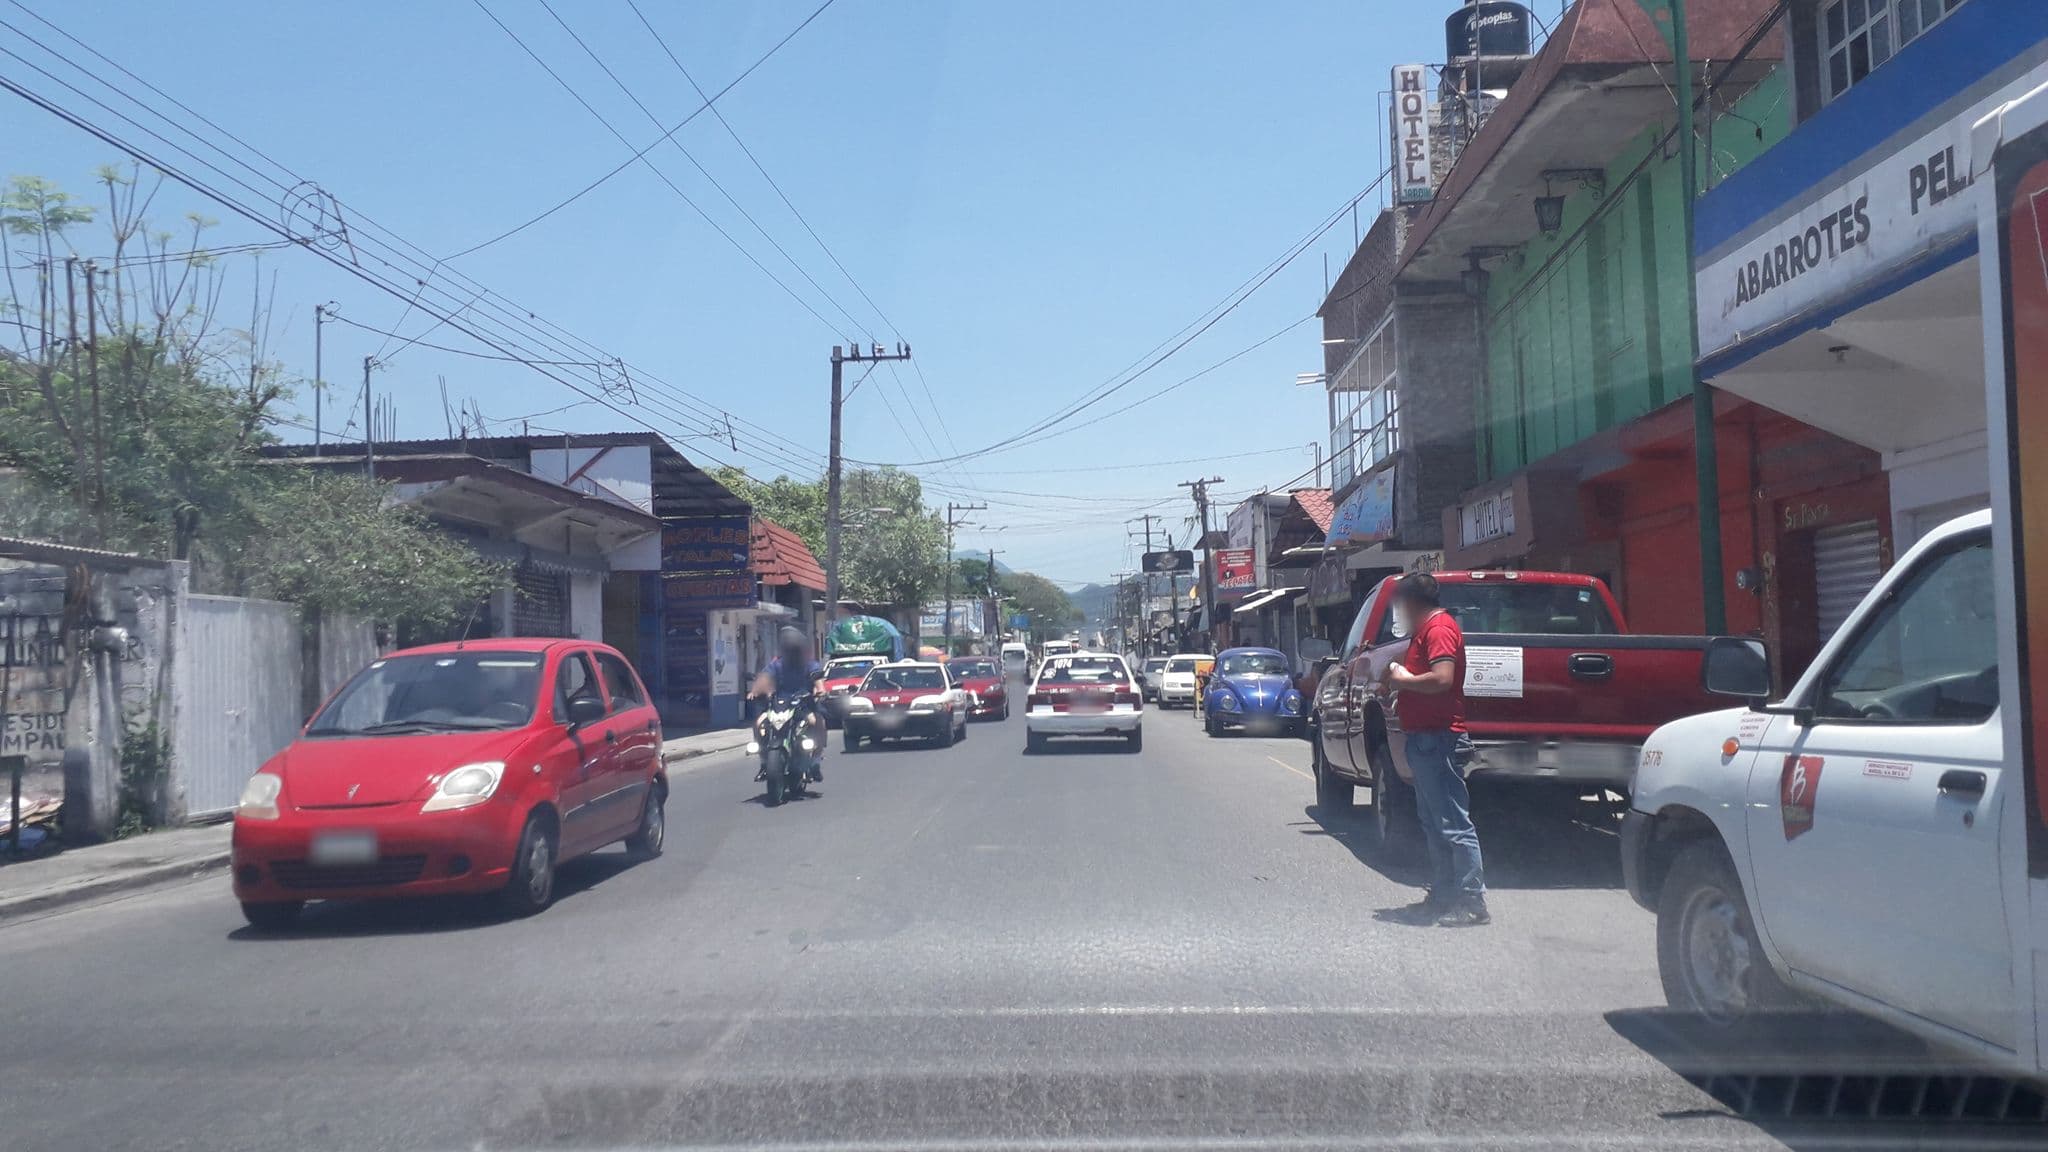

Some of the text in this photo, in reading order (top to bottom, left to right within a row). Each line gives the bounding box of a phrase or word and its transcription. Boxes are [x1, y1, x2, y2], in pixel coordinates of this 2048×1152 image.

[1400, 70, 1426, 185] HOTEL
[1735, 195, 1871, 308] ABARROTES
[1472, 499, 1499, 541] HOTEL
